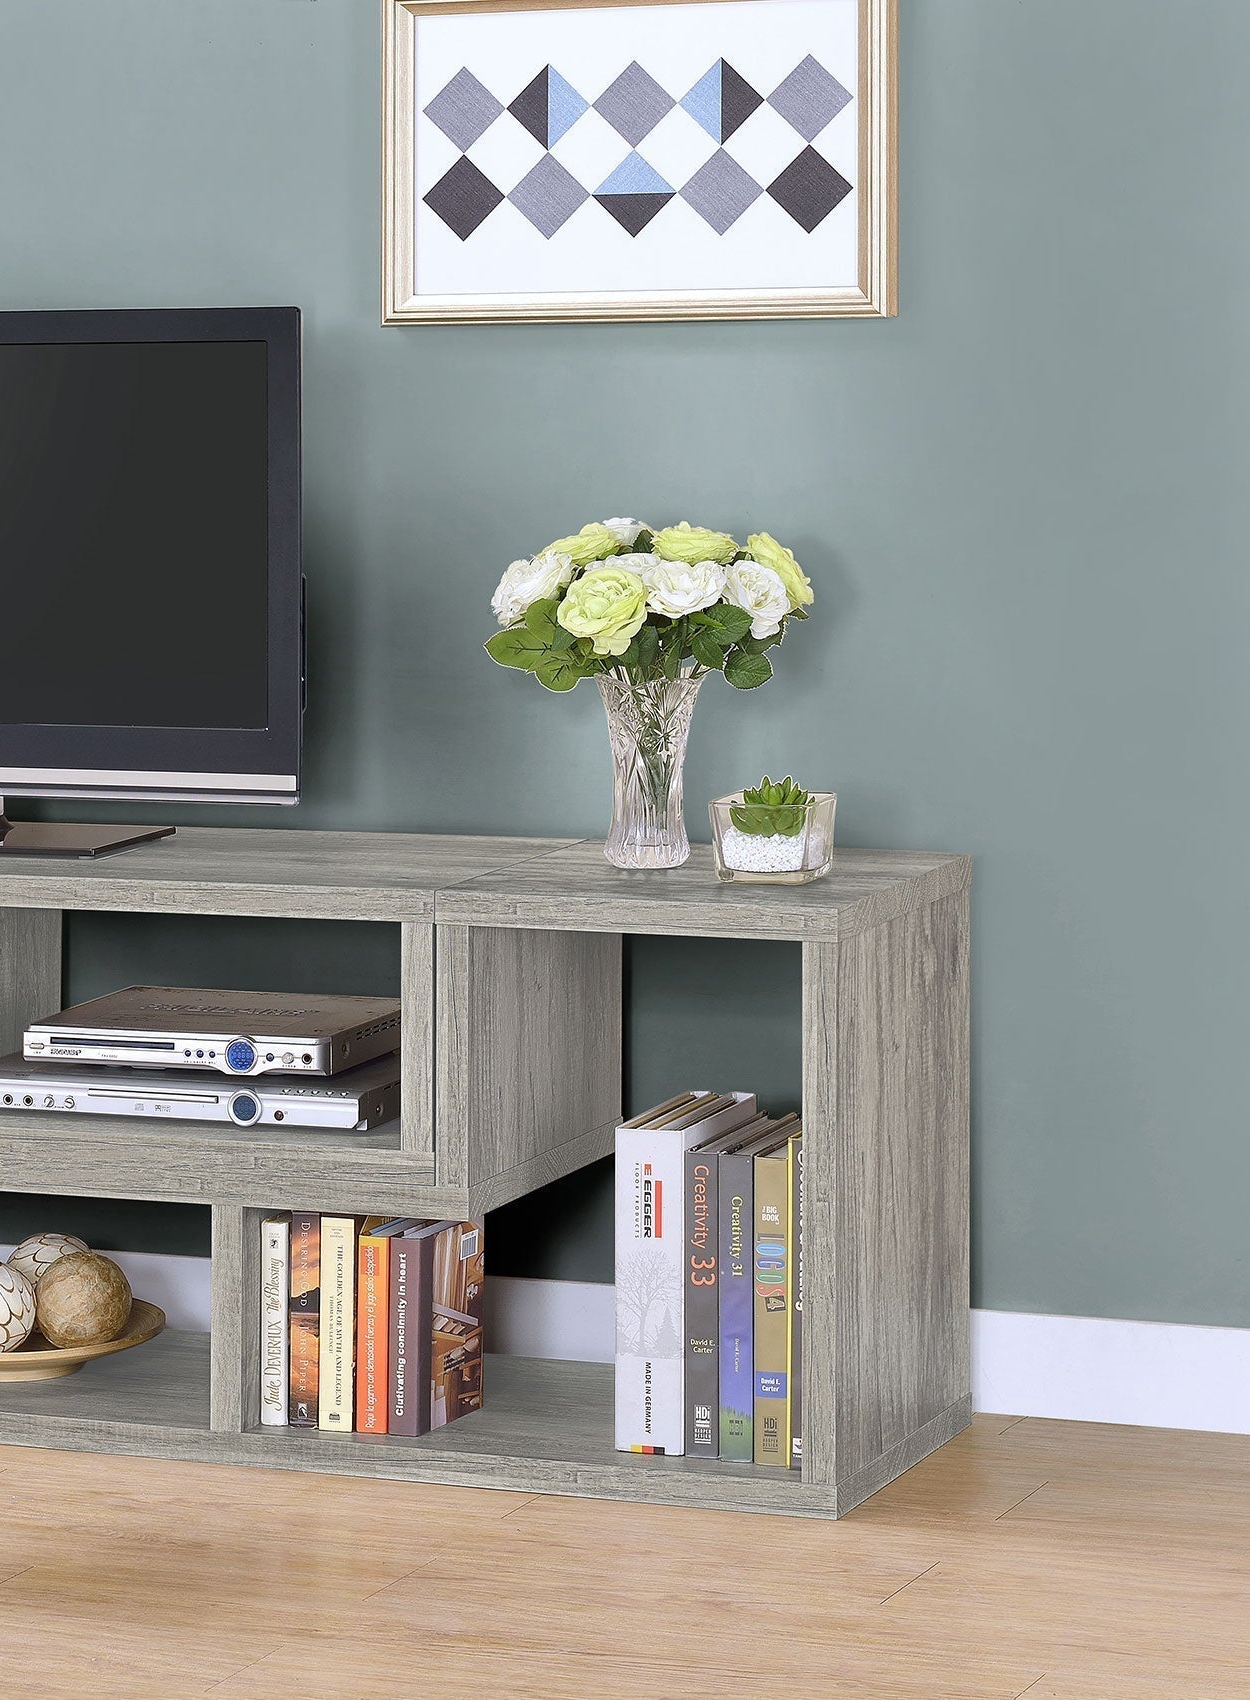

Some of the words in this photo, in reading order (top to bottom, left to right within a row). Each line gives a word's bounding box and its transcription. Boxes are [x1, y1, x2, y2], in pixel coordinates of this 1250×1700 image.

[644, 1180, 652, 1239] EGGER
[691, 1165, 710, 1249] Creativity
[761, 1213, 779, 1222] BOOK
[766, 1205, 778, 1214] BIG
[729, 1196, 744, 1260] Creativity
[301, 1222, 310, 1277] DESIRING
[263, 1257, 284, 1299] Blessing
[397, 1252, 407, 1283] heart
[691, 1255, 716, 1287] 33
[731, 1262, 743, 1277] 31
[756, 1233, 786, 1297] LOGOS
[265, 1297, 280, 1315] The
[300, 1281, 310, 1307] GOD
[336, 1316, 343, 1328] OF
[364, 1319, 375, 1339] fuerza
[396, 1298, 408, 1355] concinnity
[263, 1319, 283, 1376] DEVERAUX
[299, 1325, 310, 1354] JOHN
[690, 1339, 708, 1347] David
[709, 1339, 716, 1347] E.
[693, 1346, 714, 1354] Carter
[299, 1360, 309, 1391] PIPER
[367, 1373, 375, 1384] con
[395, 1357, 407, 1417] Clutivating
[760, 1377, 775, 1385] David
[263, 1379, 283, 1412] Jude
[645, 1386, 652, 1395] IN
[695, 1406, 711, 1420] HDi
[764, 1417, 778, 1430] HDi
